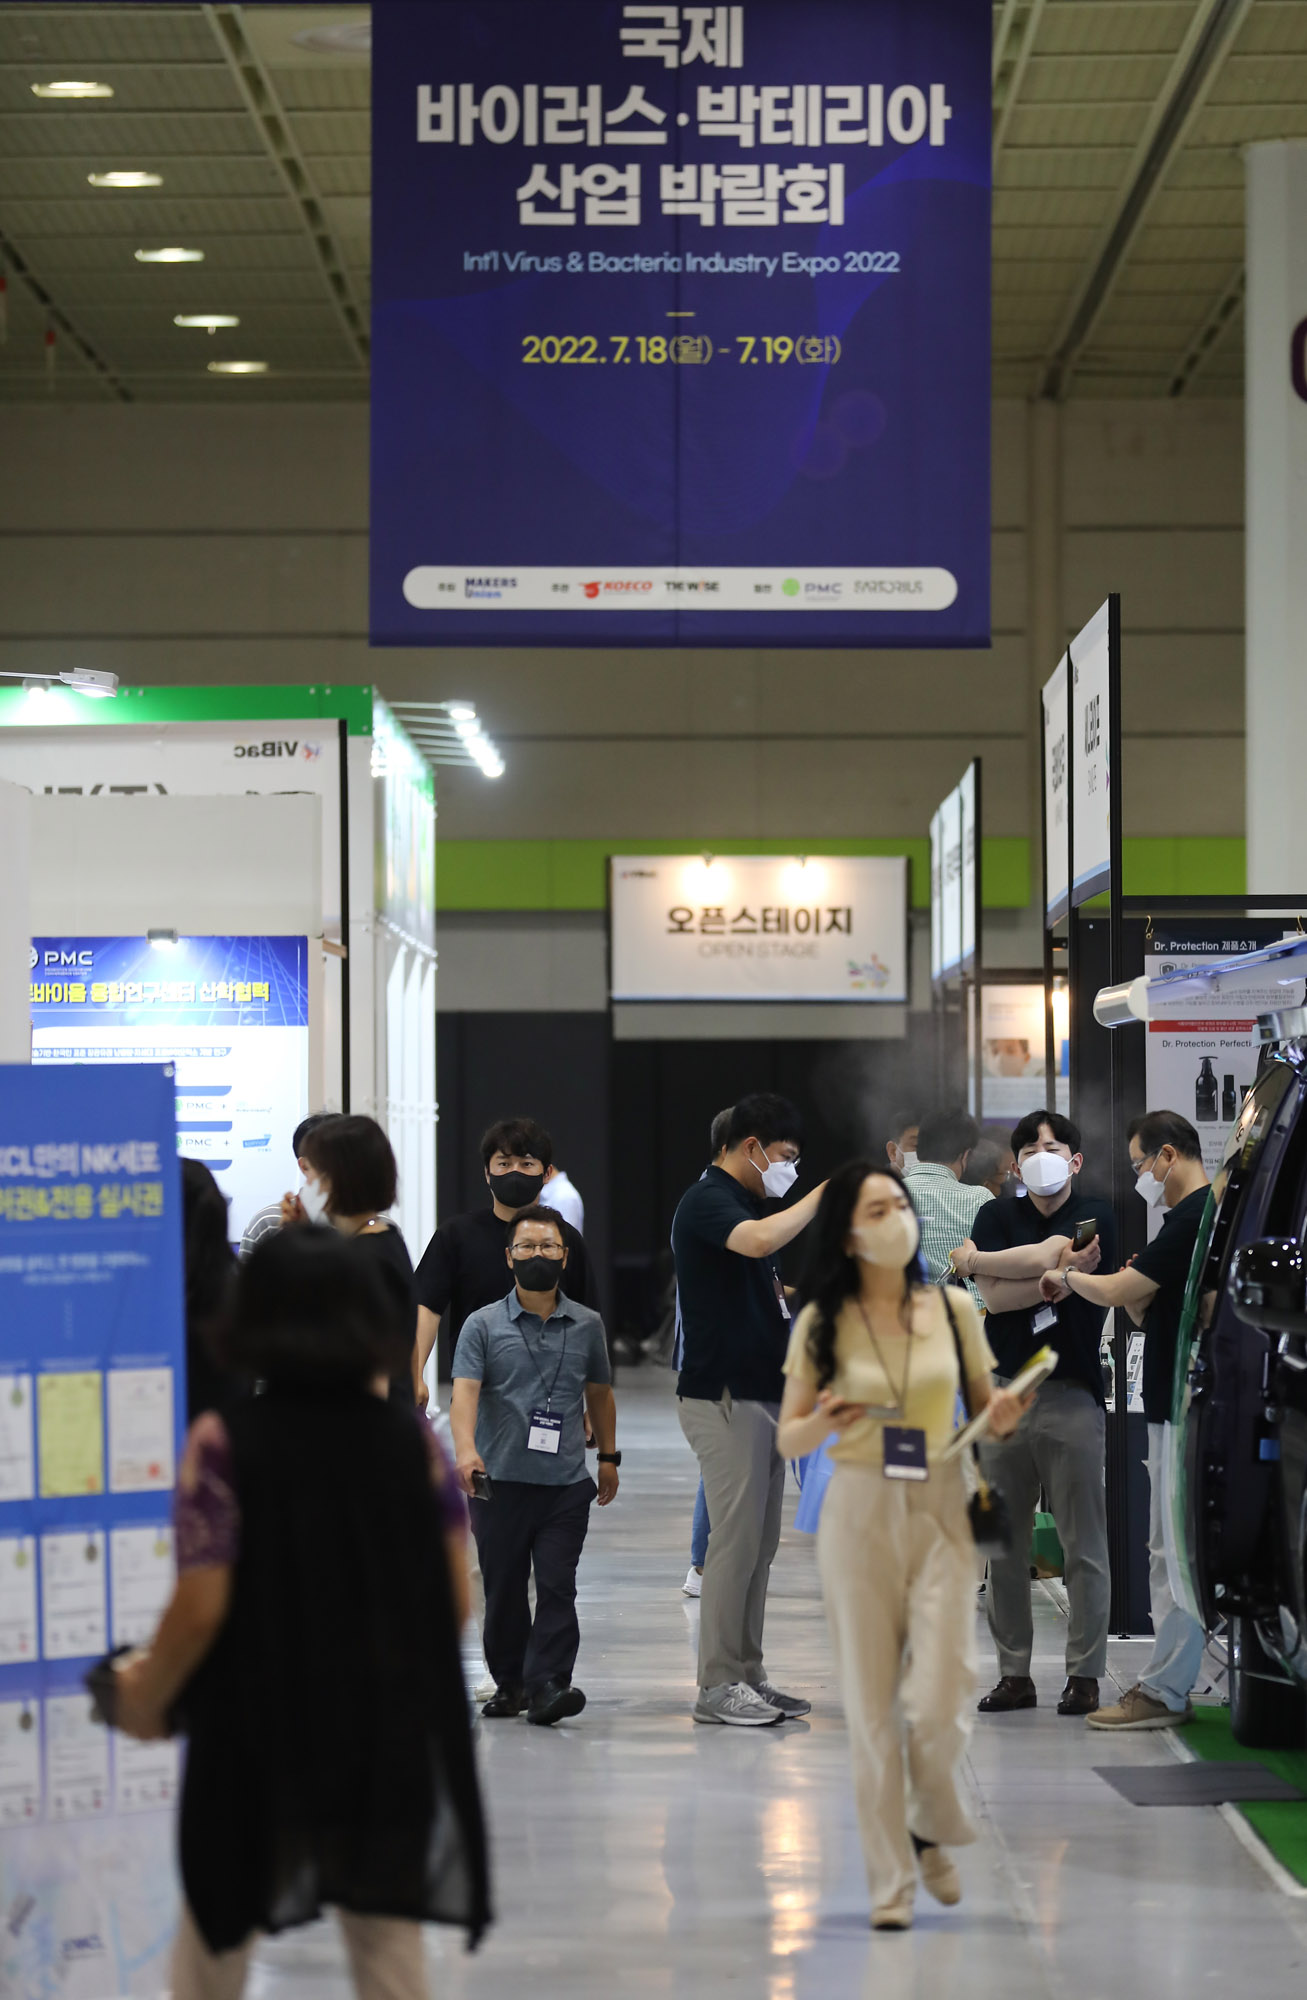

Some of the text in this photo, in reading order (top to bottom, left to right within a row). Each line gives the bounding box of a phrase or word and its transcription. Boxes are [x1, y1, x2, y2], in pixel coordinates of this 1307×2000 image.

[620, 5, 743, 68] 국제
[416, 84, 952, 148] 바이러스·박테리아
[516, 163, 845, 227] 산업 박람회
[503, 251, 561, 273] Virus
[566, 252, 583, 273] &
[588, 251, 682, 273] Bacteria
[686, 251, 778, 278] Industry
[782, 252, 841, 277] Expo
[843, 252, 900, 273] 2022
[804, 582, 842, 594] PMC
[666, 906, 853, 935] 오픈스테이지
[1154, 940, 1257, 951] Dr. Protection 제품소개
[45, 950, 93, 966] PMC
[1162, 1039, 1172, 1048] Dr.
[1175, 1039, 1216, 1048] Protection
[186, 1102, 213, 1110] PMC
[185, 1138, 212, 1146] PMC
